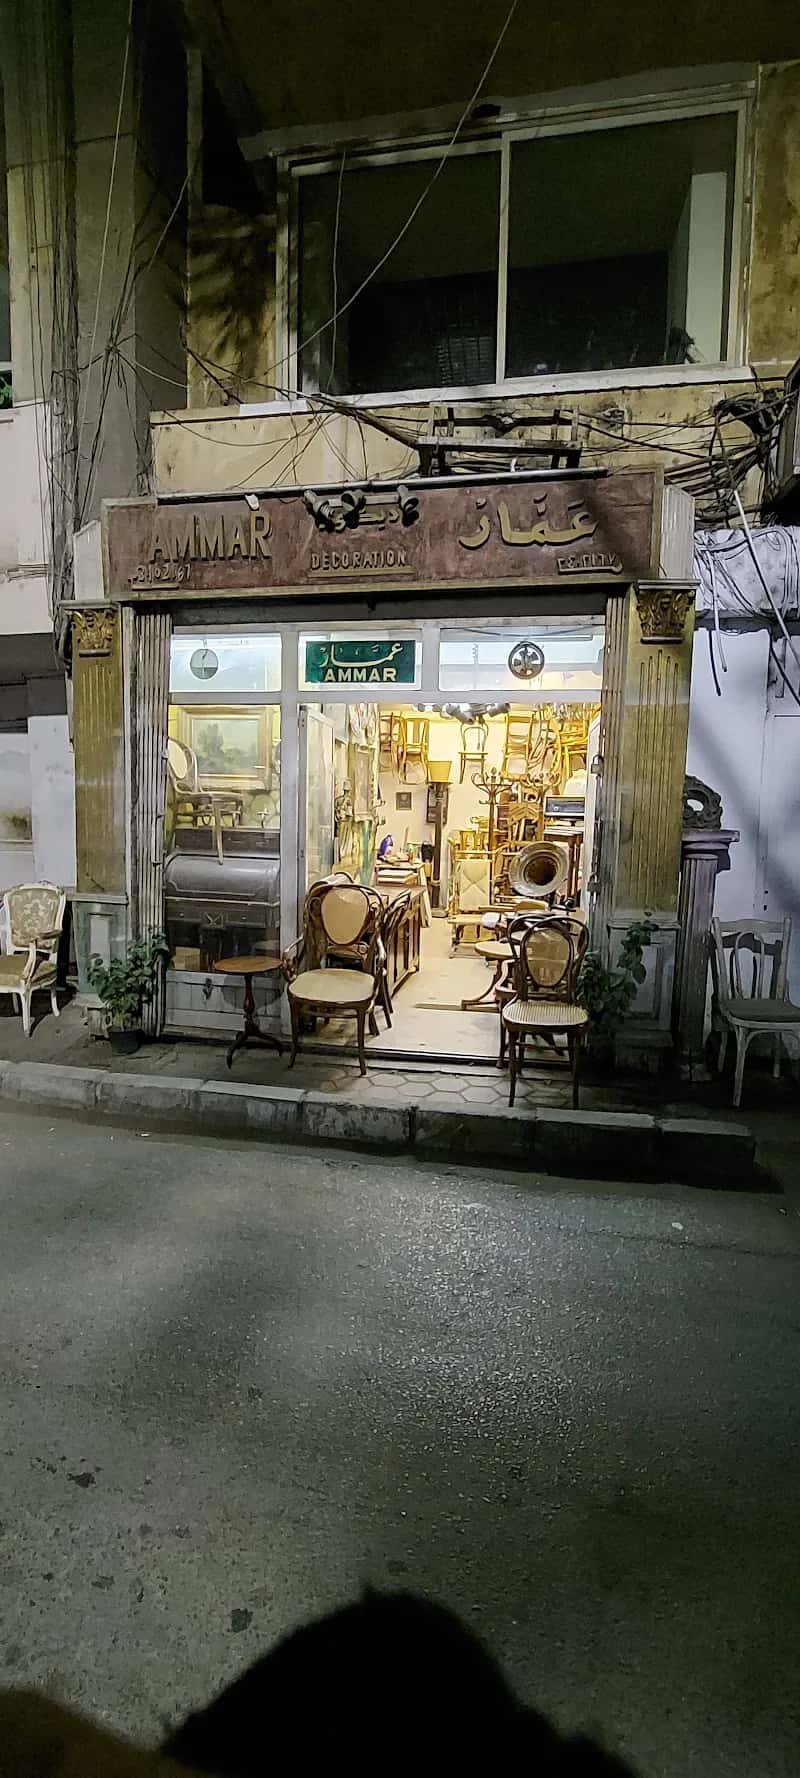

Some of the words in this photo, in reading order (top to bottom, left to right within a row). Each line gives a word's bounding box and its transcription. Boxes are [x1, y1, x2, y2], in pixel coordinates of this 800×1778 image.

[147, 510, 272, 561] AMMAR
[310, 550, 407, 571] DECORATION
[323, 667, 397, 682] AMMAR
